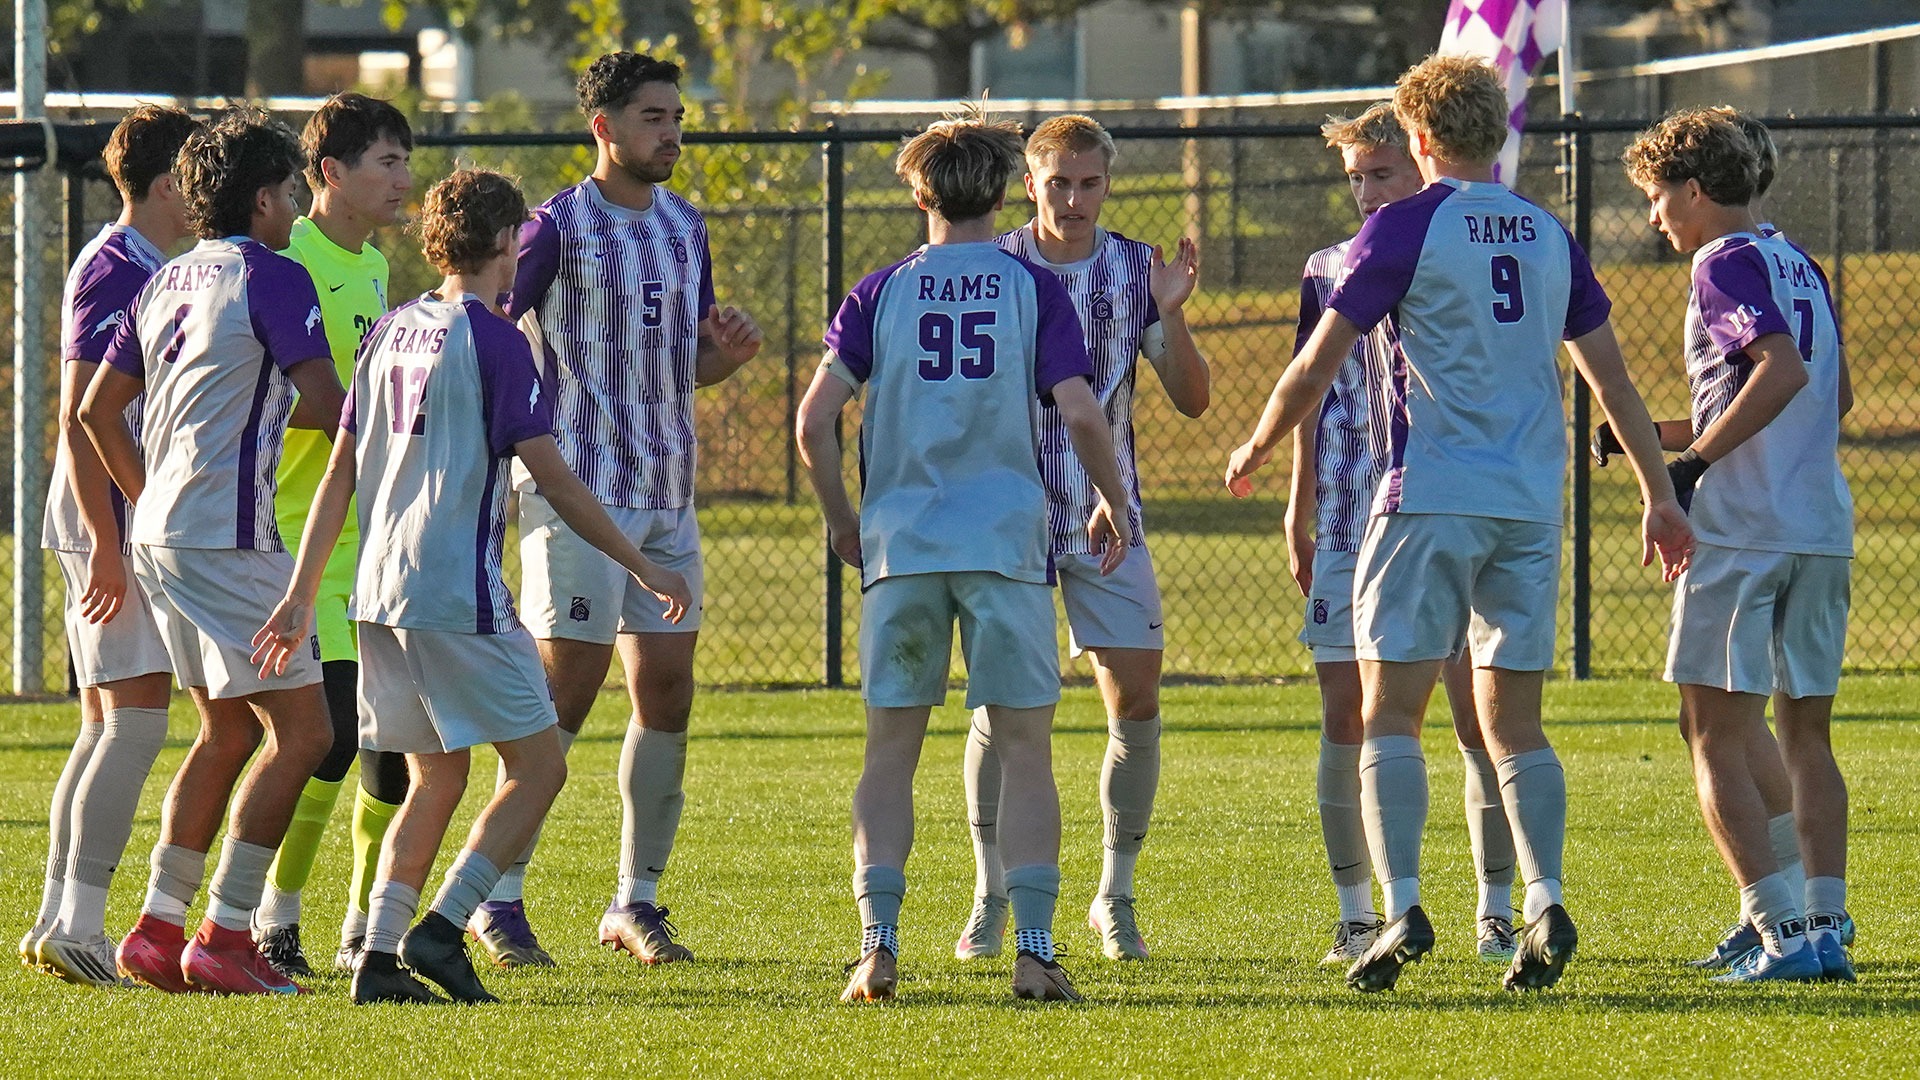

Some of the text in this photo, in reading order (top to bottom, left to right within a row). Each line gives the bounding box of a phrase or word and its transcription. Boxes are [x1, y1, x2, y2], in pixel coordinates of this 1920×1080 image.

[1463, 214, 1538, 244] RAMS
[165, 263, 223, 292] RAMS
[917, 272, 1002, 303] RAMS
[1489, 252, 1526, 325] 9
[641, 280, 663, 329] 5
[389, 326, 449, 355] RAMS
[917, 309, 998, 383] 95
[389, 364, 428, 437] 12
